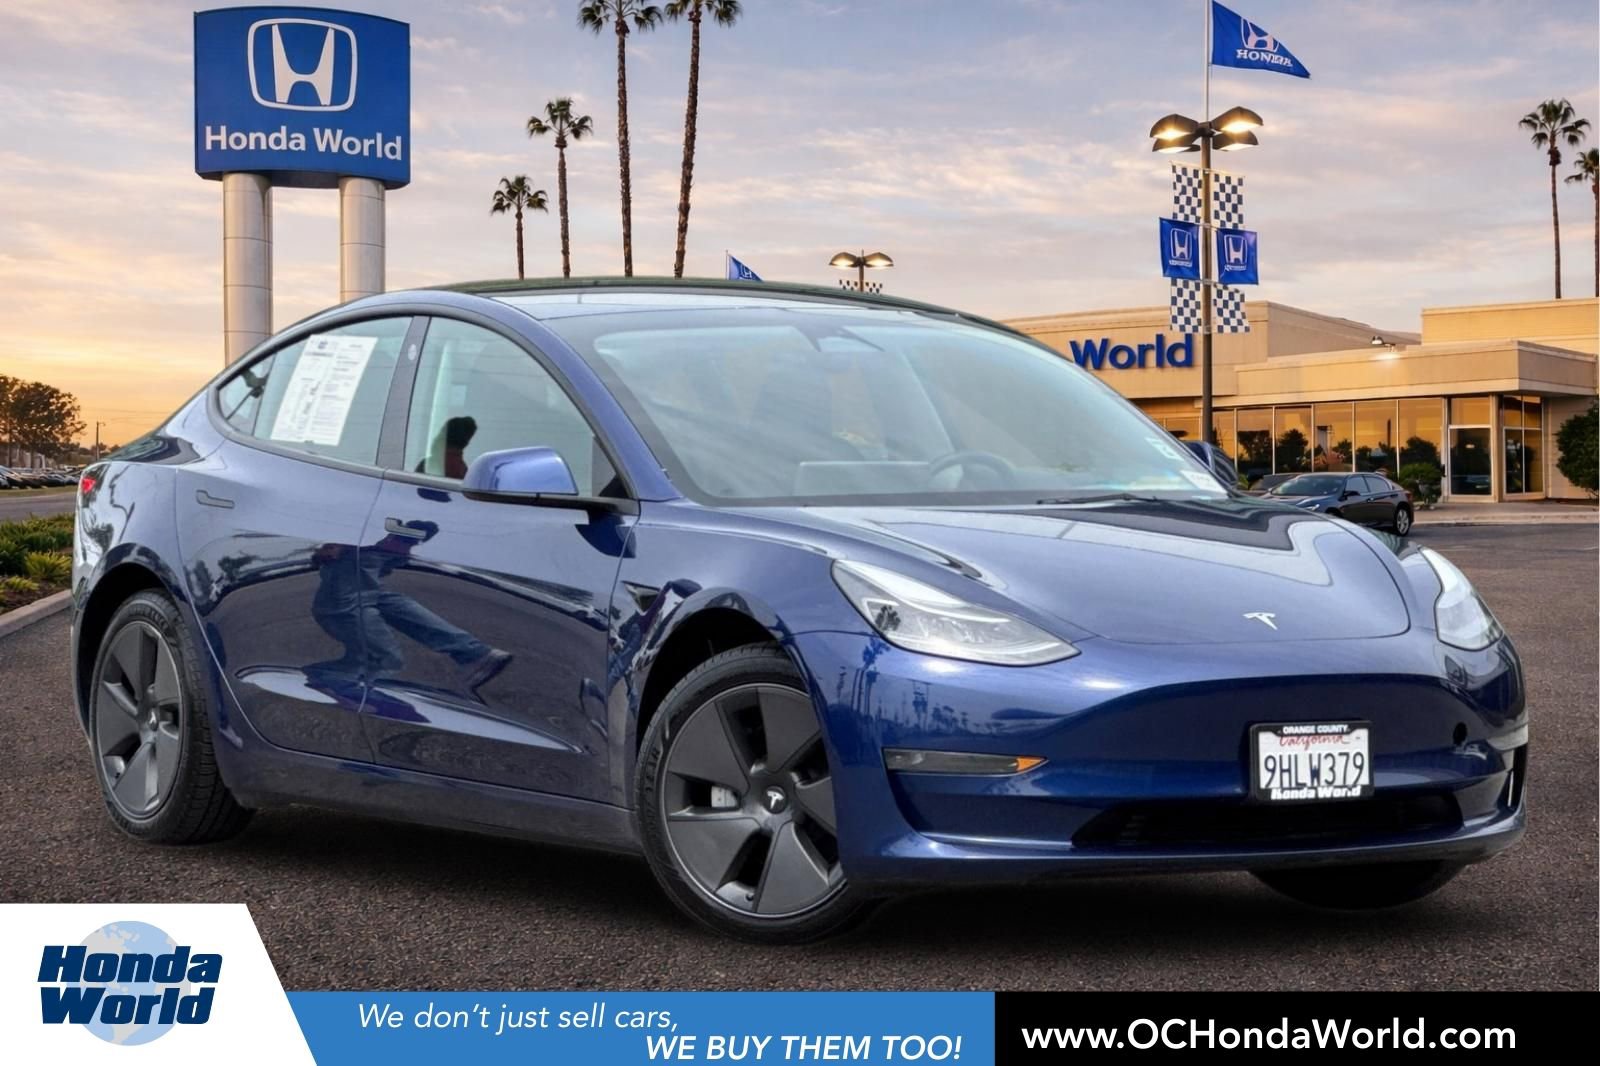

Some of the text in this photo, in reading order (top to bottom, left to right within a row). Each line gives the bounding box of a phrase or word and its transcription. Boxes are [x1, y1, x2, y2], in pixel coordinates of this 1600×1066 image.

[1236, 48, 1293, 67] HONDA
[205, 125, 402, 160] Honda World
[1069, 333, 1194, 370] World
[1282, 724, 1349, 735] ORANGE COUNTY
[1264, 752, 1365, 789] 9HLW379
[1270, 785, 1361, 800] Honda World
